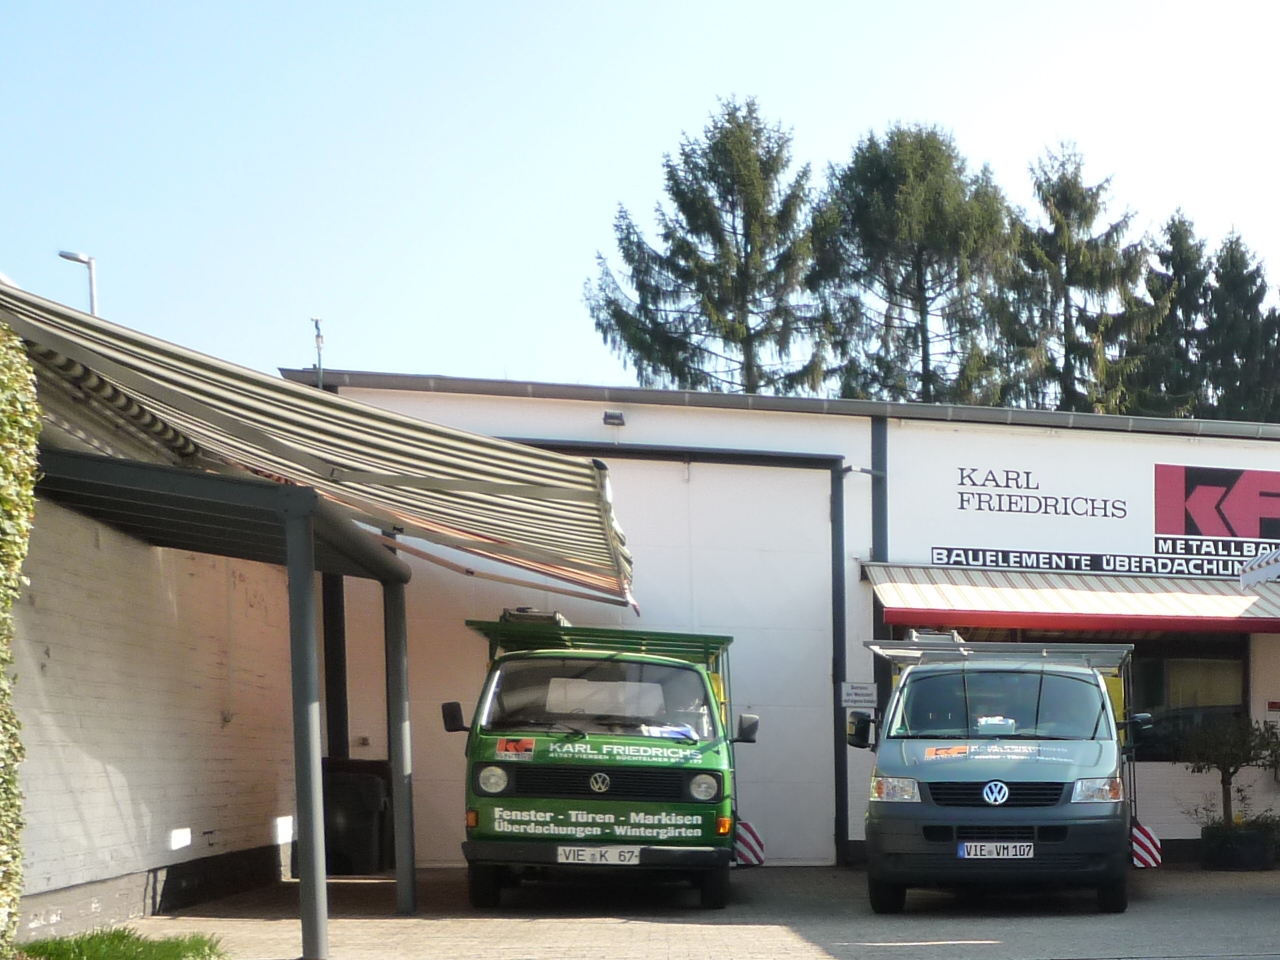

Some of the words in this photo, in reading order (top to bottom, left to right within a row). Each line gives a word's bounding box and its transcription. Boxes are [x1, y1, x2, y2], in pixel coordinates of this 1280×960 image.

[957, 467, 1040, 490] KARL
[957, 491, 1127, 518] FRIEDRICHS
[932, 548, 1092, 570] BAUELEMENTE
[1102, 554, 1246, 576] ÜBERDACHUN
[549, 743, 598, 754] KARL
[603, 745, 702, 759] FRIEDRICHS
[494, 807, 554, 821] Fenster
[568, 810, 615, 823] Türen
[630, 811, 702, 824] Markisen
[494, 819, 601, 838] Überdachungen
[614, 825, 702, 839] Wintergärten
[562, 849, 586, 861] VIE
[599, 850, 608, 862] K
[618, 850, 634, 862] 67
[965, 844, 986, 857] VIE
[995, 844, 1009, 857] VM
[1012, 844, 1032, 857] 107
